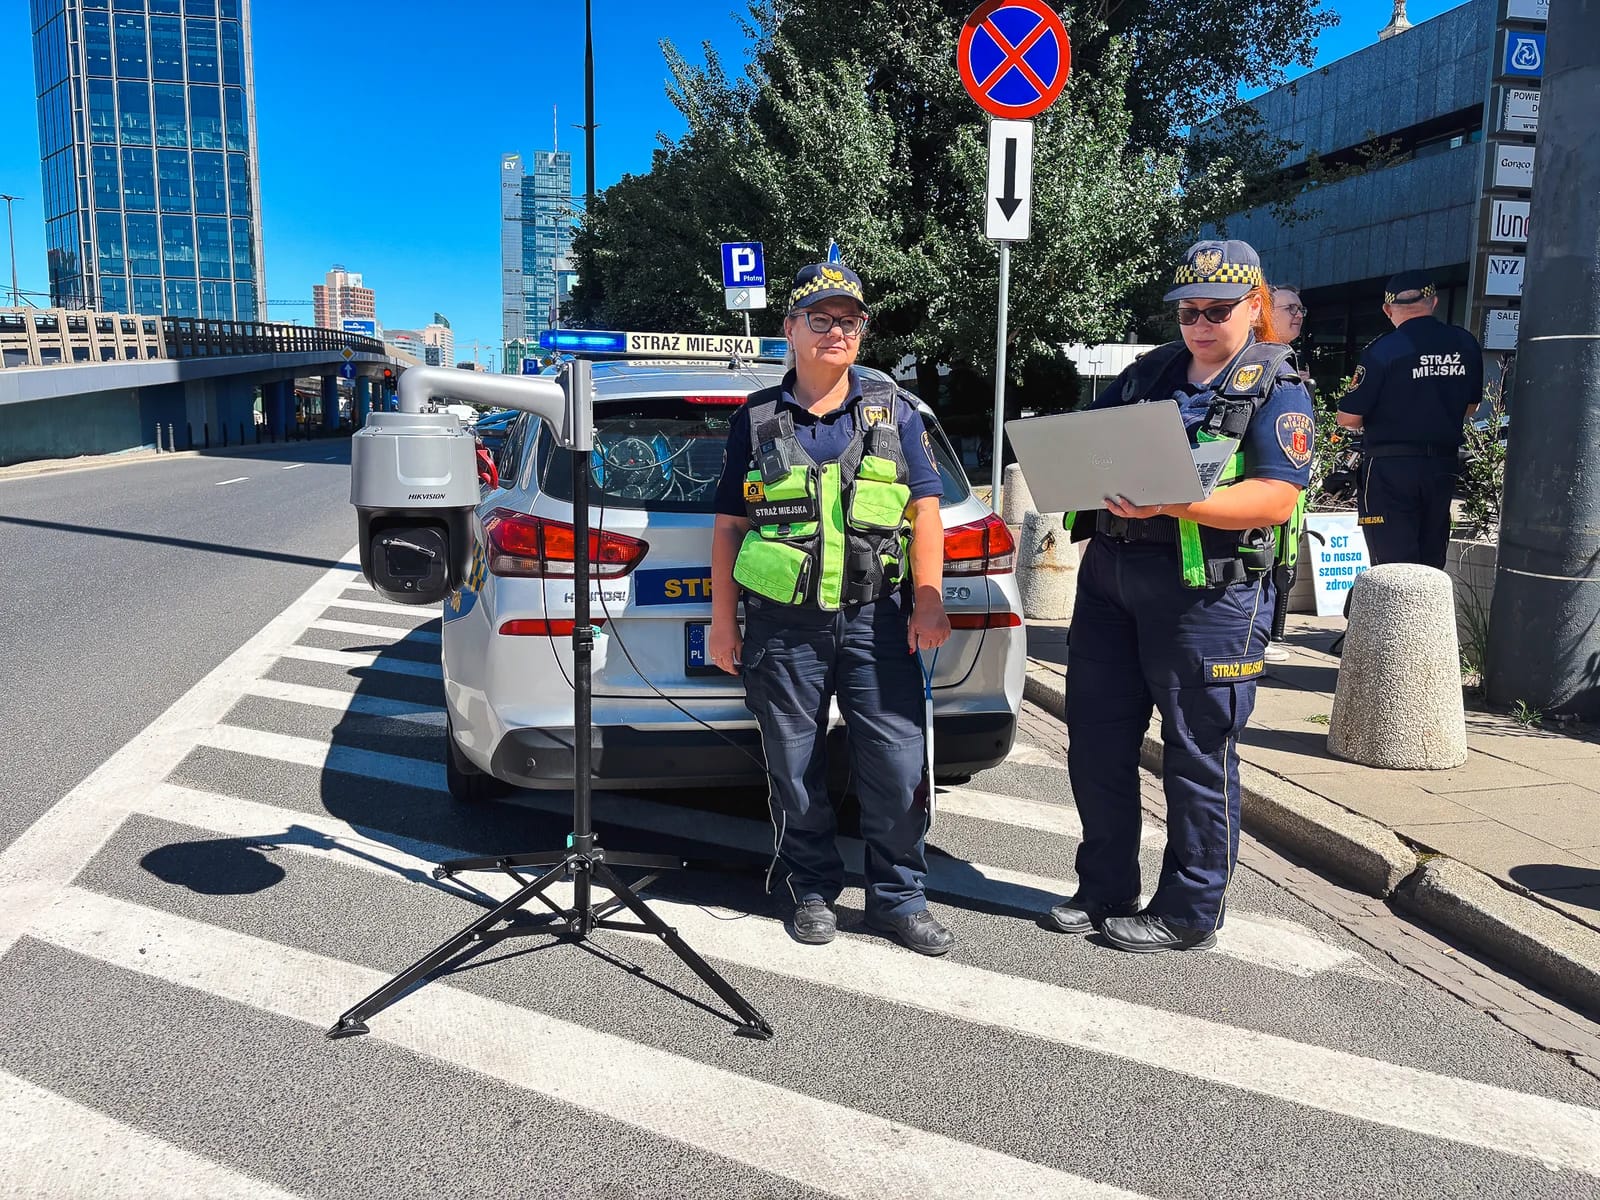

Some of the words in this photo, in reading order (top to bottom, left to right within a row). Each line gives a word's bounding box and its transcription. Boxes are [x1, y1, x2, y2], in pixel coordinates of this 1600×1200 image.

[504, 161, 516, 170] EY
[731, 247, 756, 282] P
[1489, 259, 1520, 275] NFZ
[686, 337, 755, 354] MIEJSKA
[1420, 351, 1461, 365] STRAŻ
[1412, 365, 1466, 379] MIEJSKA
[408, 493, 446, 501] HIKVISION
[755, 505, 778, 517] STRAŻ
[778, 505, 808, 515] MIEJSKA
[1330, 535, 1349, 548] SCT
[1321, 551, 1331, 562] to
[1334, 552, 1362, 562] nasza
[1319, 566, 1353, 577] szansa
[564, 591, 627, 603] HNDAI
[691, 650, 703, 660] PL
[1212, 662, 1240, 678] STRAŻ
